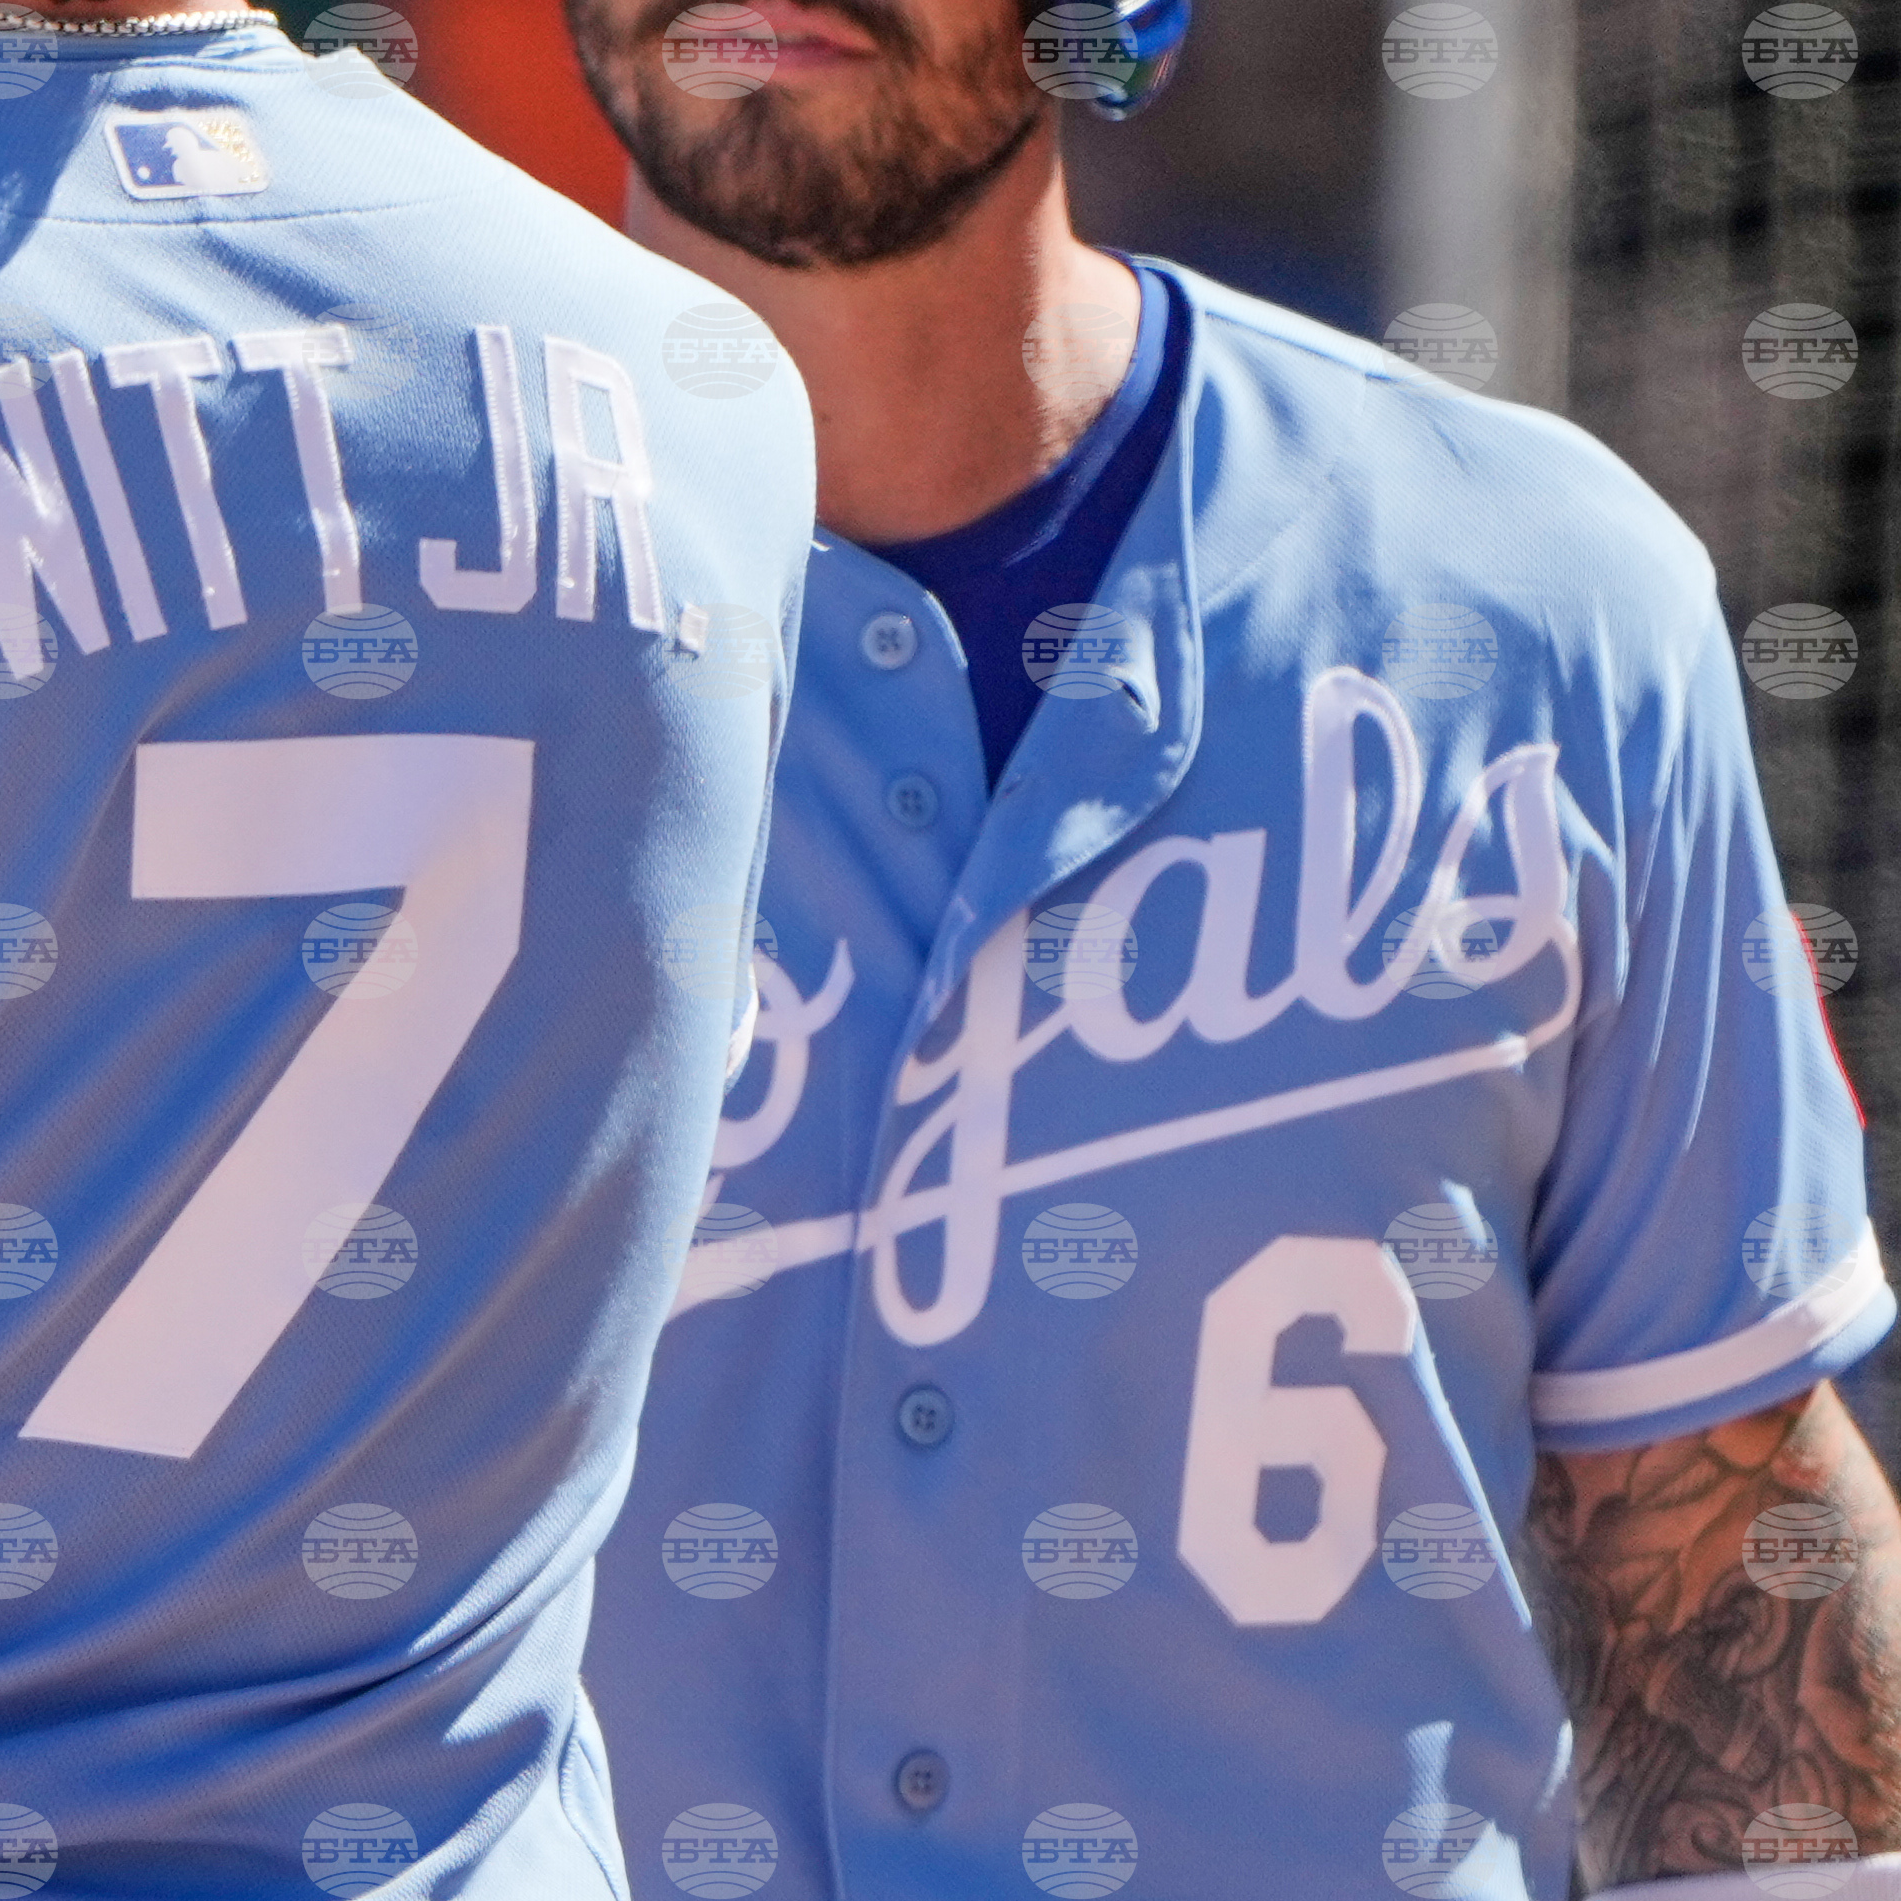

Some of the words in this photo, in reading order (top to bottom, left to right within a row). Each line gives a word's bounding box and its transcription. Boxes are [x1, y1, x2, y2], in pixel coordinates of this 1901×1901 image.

[419, 325, 709, 656] JR.
[18, 733, 535, 1458] 7
[689, 666, 1580, 1346] oyals
[1178, 1235, 1414, 1625] 6
